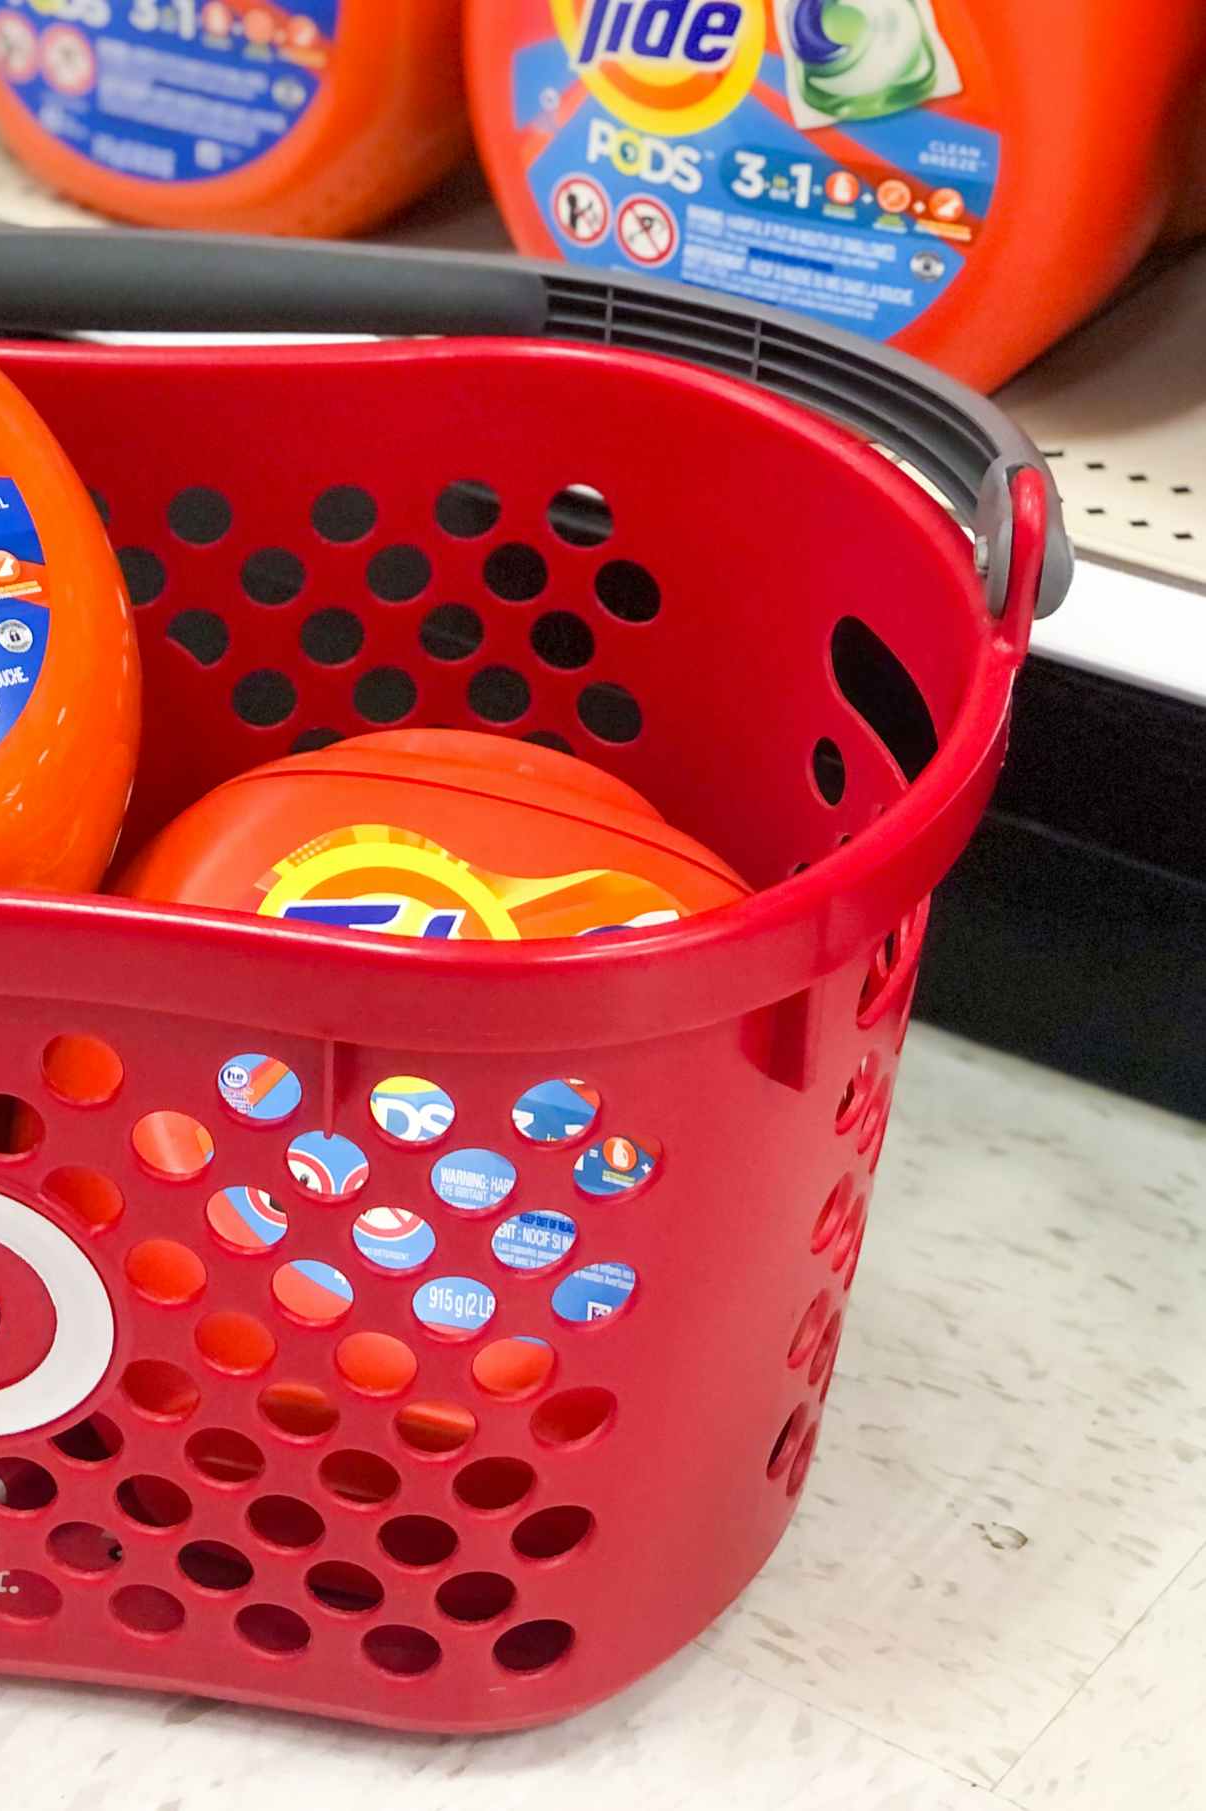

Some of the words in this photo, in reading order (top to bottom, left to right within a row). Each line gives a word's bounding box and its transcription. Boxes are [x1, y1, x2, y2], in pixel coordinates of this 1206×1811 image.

[586, 118, 703, 194] PODS
[227, 1070, 244, 1081] he
[439, 1167, 490, 1191] WARNING:
[522, 1226, 552, 1249] NOCIF
[551, 1232, 563, 1249] SI
[428, 1285, 453, 1312] 915
[454, 1295, 464, 1318] g
[465, 1292, 478, 1320] (2
